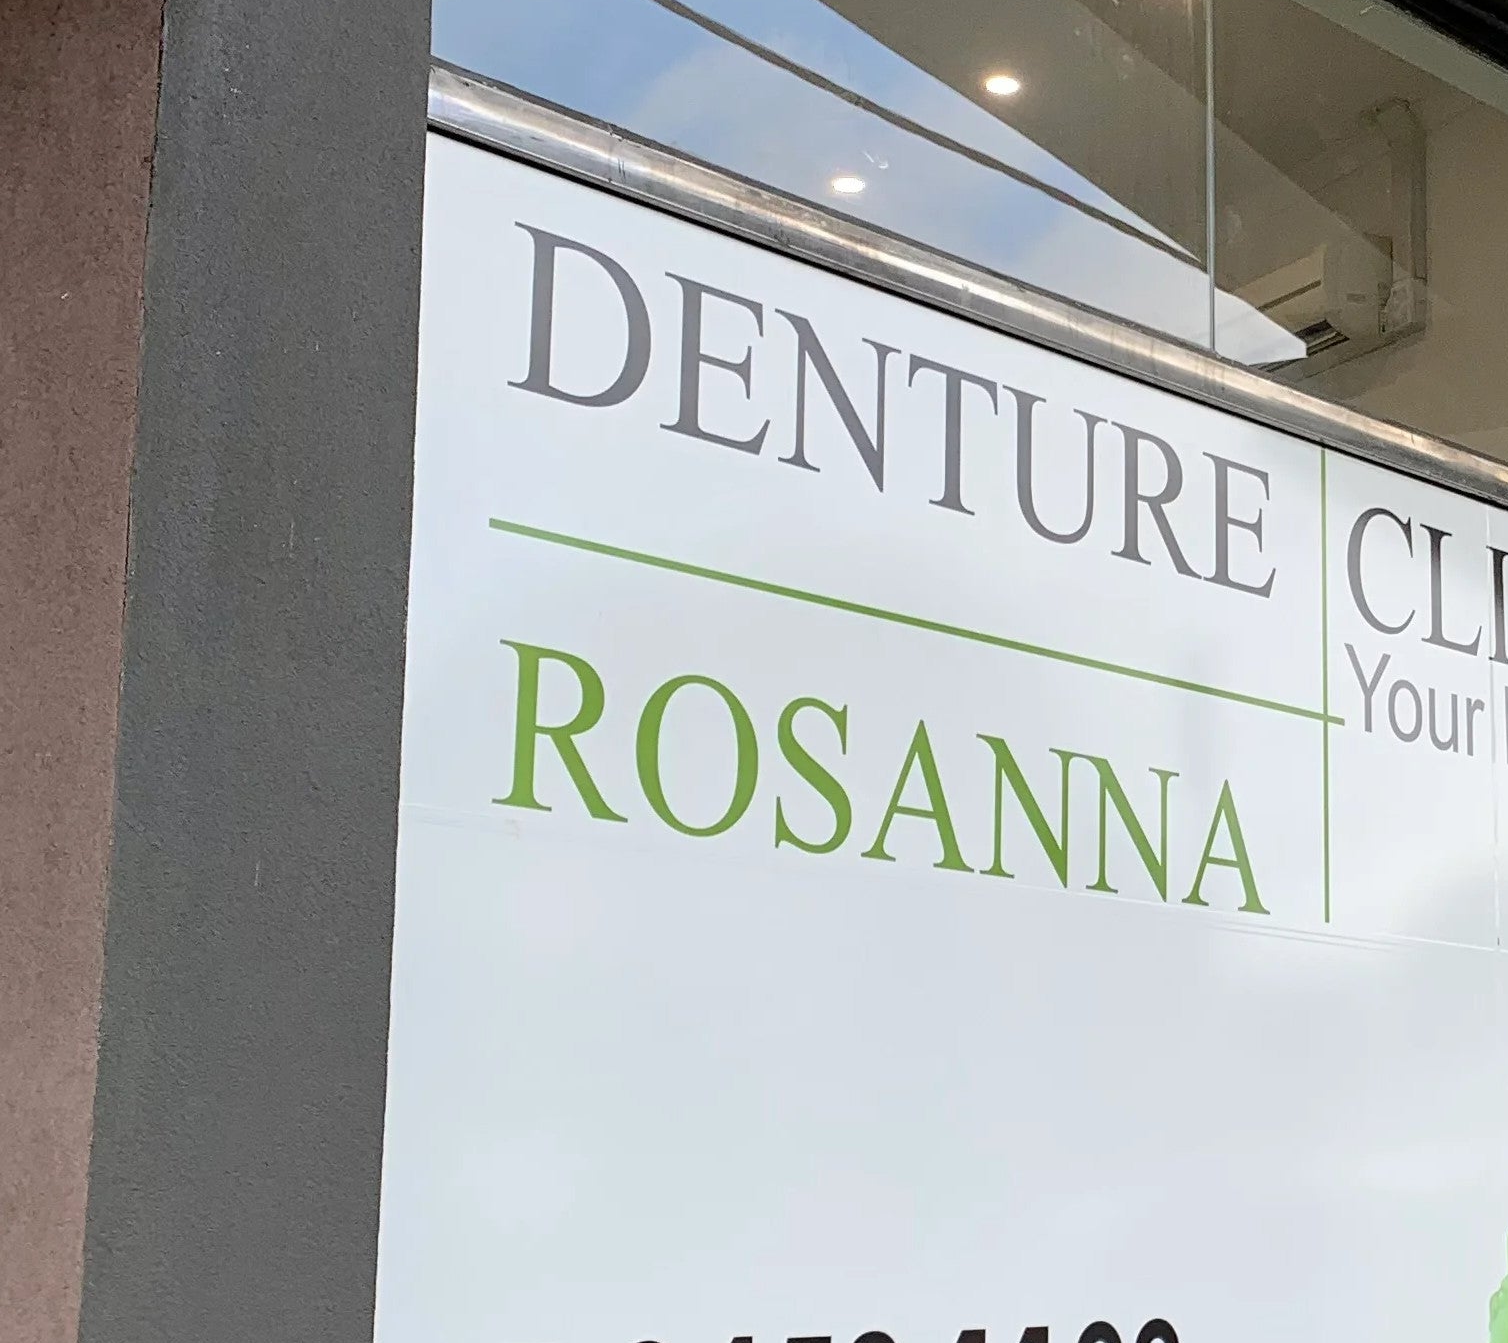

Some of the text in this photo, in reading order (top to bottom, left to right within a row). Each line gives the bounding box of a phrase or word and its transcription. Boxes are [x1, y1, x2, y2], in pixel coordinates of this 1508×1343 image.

[506, 220, 1277, 600] DENTURE
[491, 639, 1272, 916] ROSANNA
[1344, 642, 1485, 757] Your
